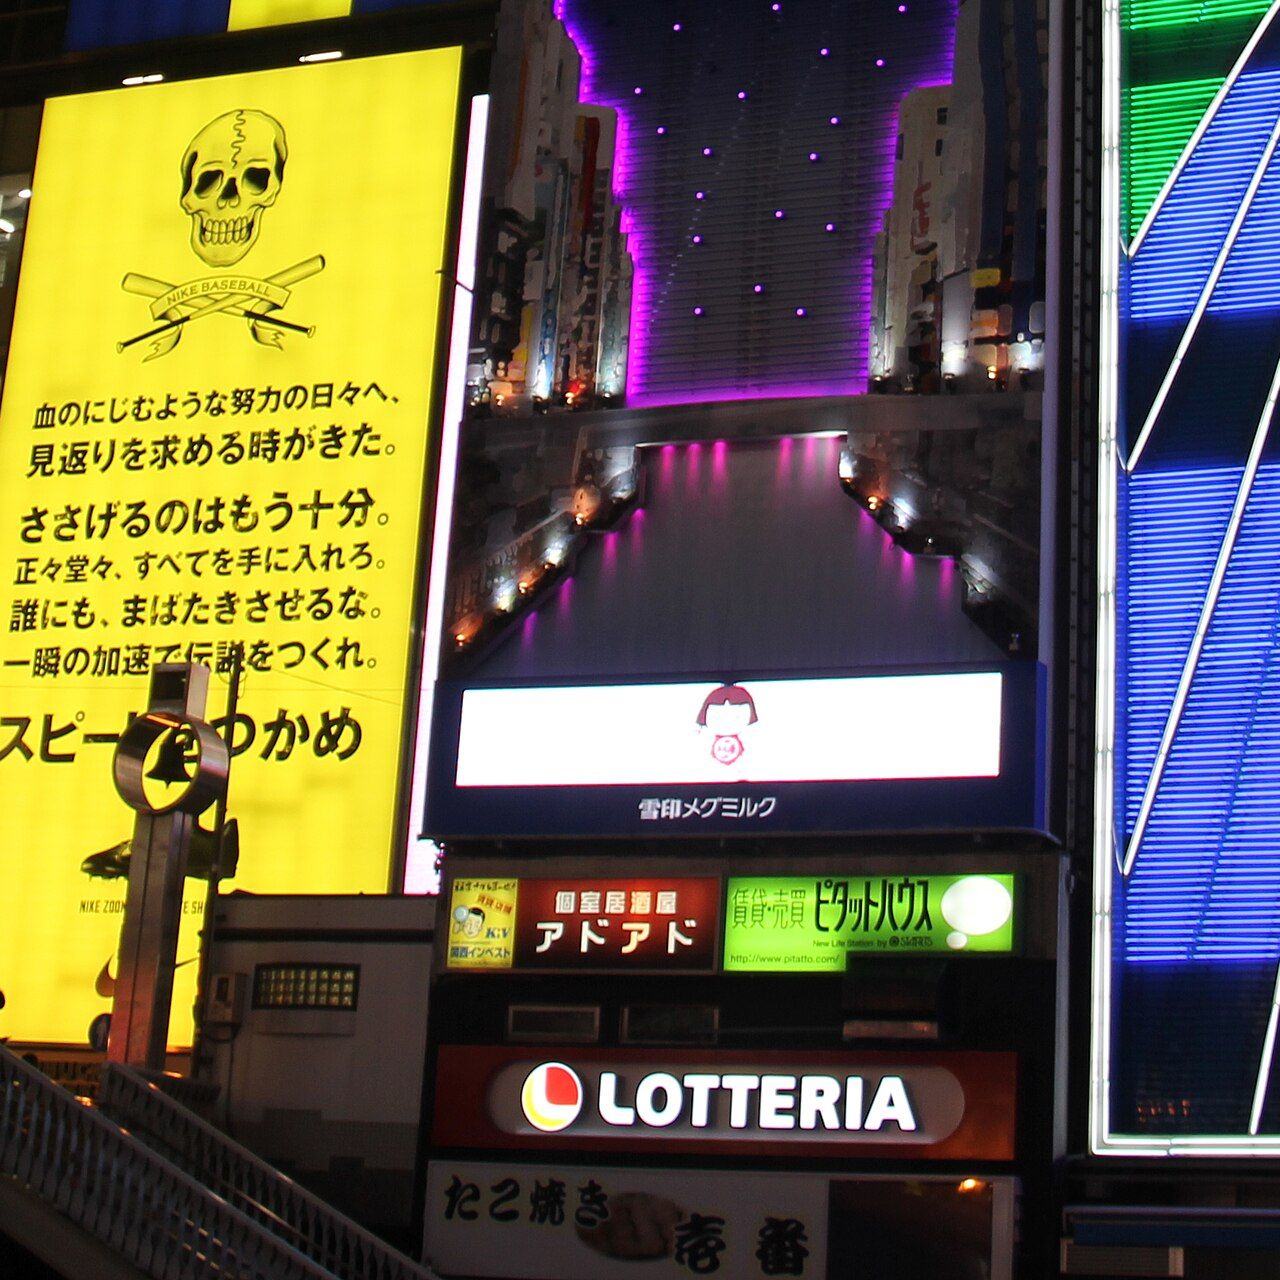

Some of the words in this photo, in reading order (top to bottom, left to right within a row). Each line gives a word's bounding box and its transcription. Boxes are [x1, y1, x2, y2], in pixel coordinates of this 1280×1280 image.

[167, 285, 198, 305] NIKE
[201, 280, 270, 297] BASEBALL
[32, 380, 401, 431] 血のにじむような努力の日々へ、
[26, 423, 397, 479] 見返りを求める時がきた。
[21, 487, 390, 545] ささげるのはもう十分。
[13, 542, 387, 587] 正々堂々、すべてを手に入れろ。
[9, 585, 381, 633] 誰にも、まばたきさせるな。
[638, 796, 776, 820] 雪印メグミルク
[80, 900, 101, 913] NIKE
[555, 891, 677, 915] 個室居酒屋
[814, 876, 933, 933] ピタットハウス
[536, 919, 697, 955] アドアド
[730, 952, 841, 964] http://www.pitatto.com/
[877, 939, 888, 948] by
[597, 1072, 917, 1131] LOTTERIA
[444, 1174, 611, 1228] たこ焼き
